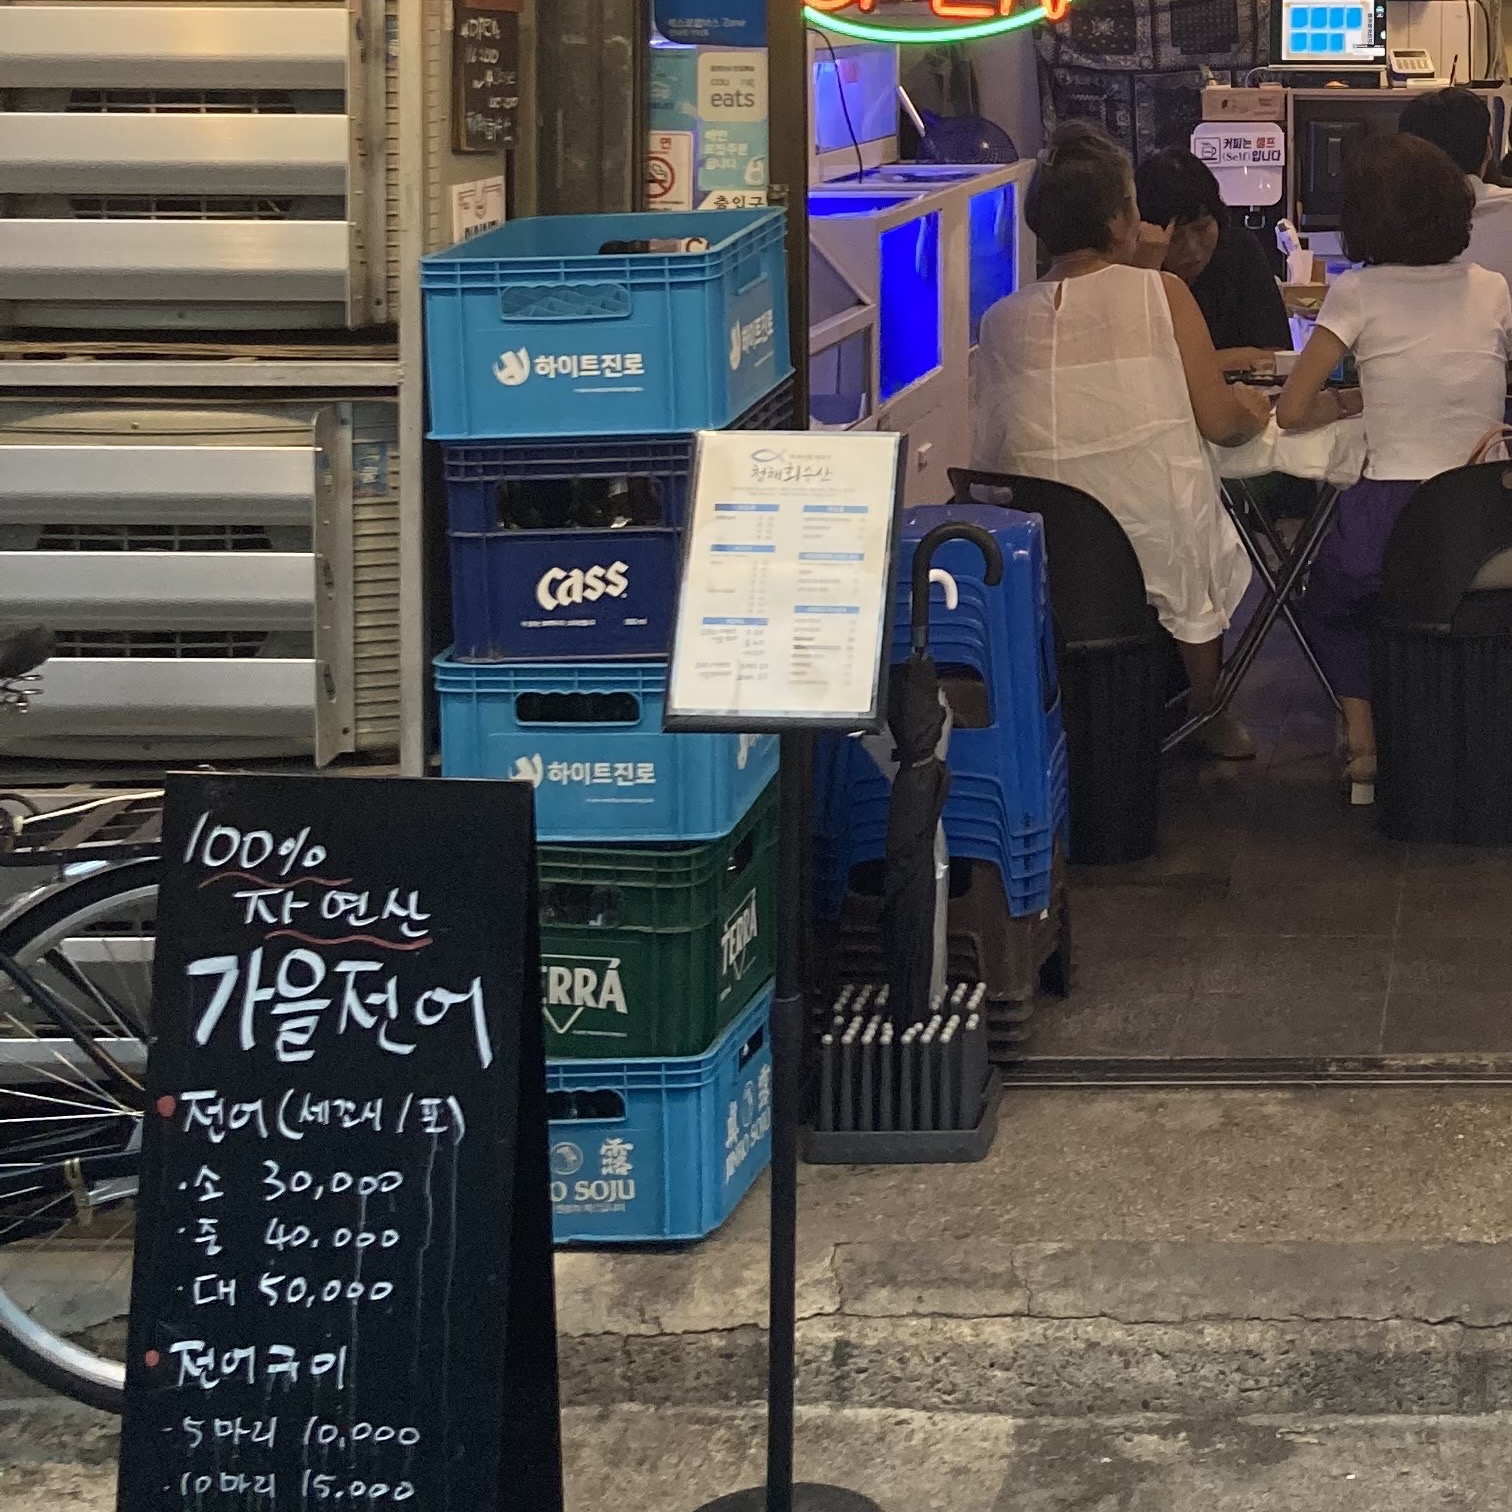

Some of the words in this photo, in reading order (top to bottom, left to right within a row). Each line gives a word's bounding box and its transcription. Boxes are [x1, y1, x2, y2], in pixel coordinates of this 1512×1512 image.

[710, 89, 756, 108] eats
[1223, 137, 1251, 150] 커피는
[1256, 137, 1276, 149] 셀프
[534, 352, 646, 380] 하이트진로
[536, 560, 630, 611] Cass
[547, 760, 657, 787] 하이트진로
[183, 811, 327, 876] 100%
[186, 946, 494, 1070] 가을전어
[541, 965, 629, 1015] RRA
[194, 1164, 225, 1202] 소
[262, 1159, 404, 1202] 30,000
[574, 1178, 636, 1203] SOJU
[193, 1273, 236, 1307] 대
[258, 1271, 394, 1308] 50,000
[168, 1339, 348, 1390] 전어구이
